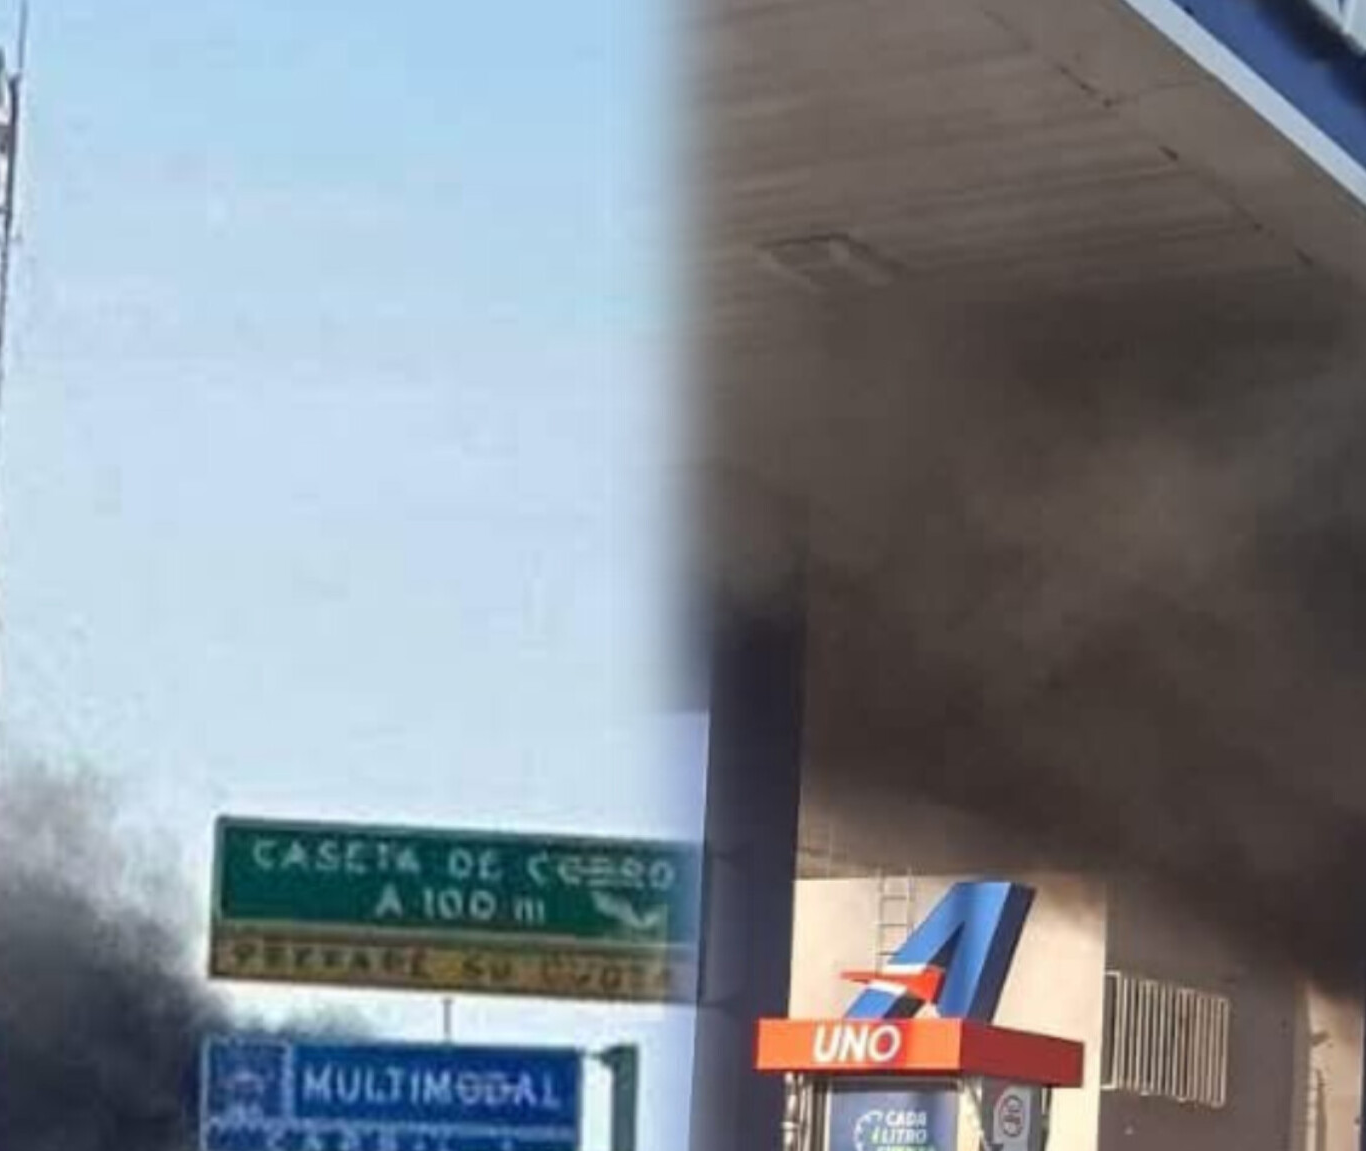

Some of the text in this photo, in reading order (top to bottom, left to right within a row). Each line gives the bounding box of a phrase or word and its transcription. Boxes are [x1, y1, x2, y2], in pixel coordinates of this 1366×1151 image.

[252, 838, 421, 875] CASETA
[448, 847, 503, 881] DE
[374, 883, 404, 919] A
[424, 887, 497, 922] 100
[812, 1024, 902, 1063] UNO
[302, 1062, 561, 1108] MULTIMODAL
